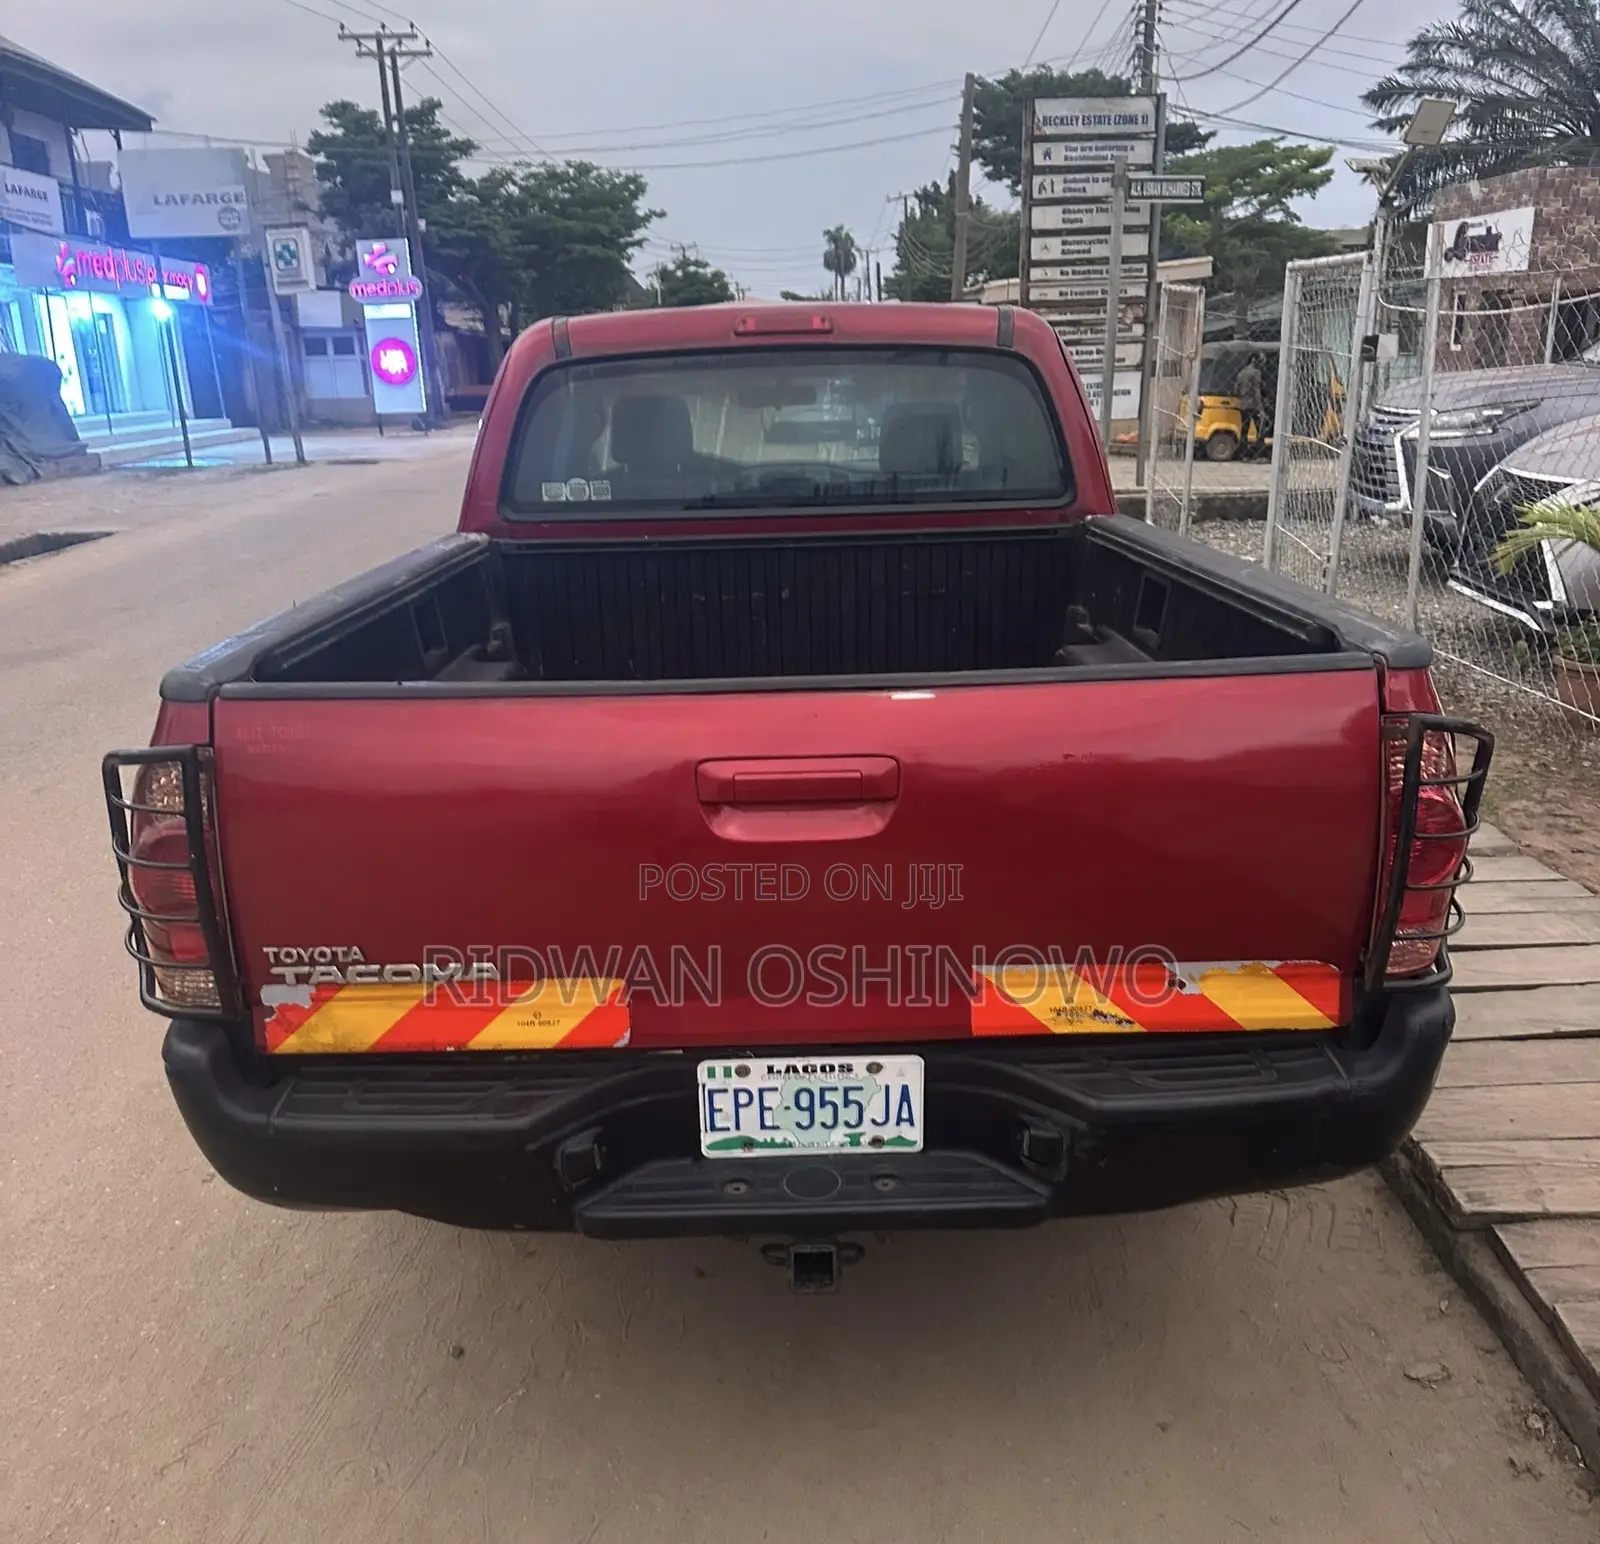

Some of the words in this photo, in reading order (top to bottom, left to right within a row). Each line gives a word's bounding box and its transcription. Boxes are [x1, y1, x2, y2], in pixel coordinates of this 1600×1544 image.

[1042, 114, 1079, 126] BECKLEY
[1081, 113, 1112, 126] ESTATE
[4, 181, 49, 202] LAFARGE
[152, 191, 244, 206] LAFARGE
[76, 245, 145, 292] medplus
[262, 946, 365, 963] TOYOTA
[270, 961, 500, 985] TACOMA
[766, 1063, 854, 1075] LAGOS
[707, 1084, 915, 1132] EPE-955JA
